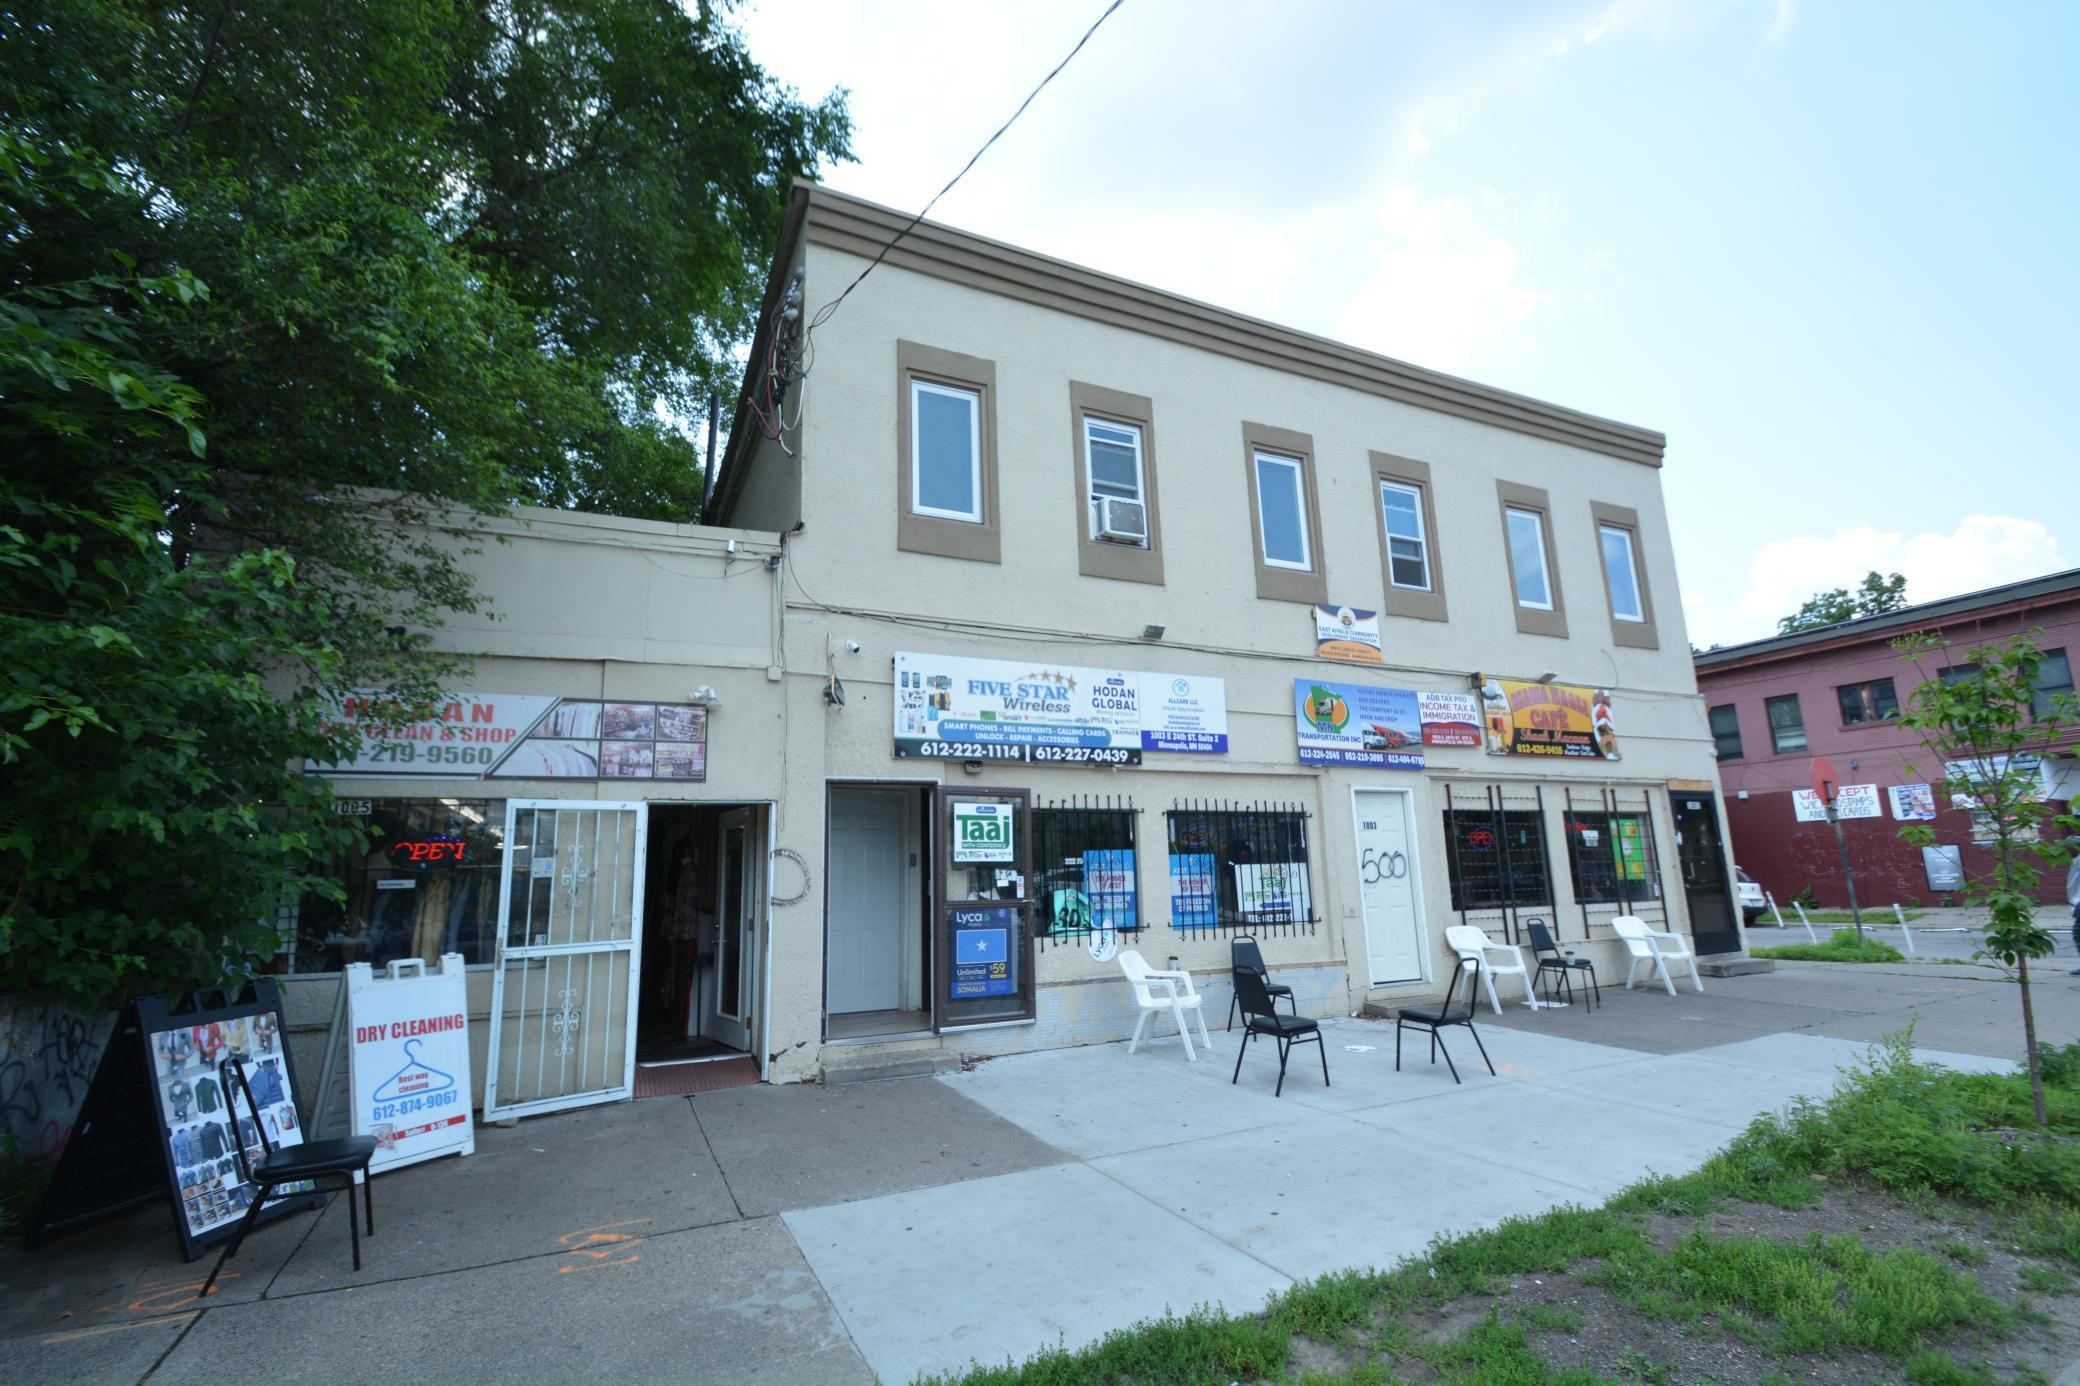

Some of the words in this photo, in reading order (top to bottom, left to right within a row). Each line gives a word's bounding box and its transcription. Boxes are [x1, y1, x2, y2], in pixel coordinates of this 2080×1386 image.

[968, 680, 1012, 696] FIVE
[1017, 683, 1069, 701] STAR
[1093, 686, 1135, 698] HODAN
[1003, 698, 1071, 713] Wireless
[1092, 698, 1137, 710] GLOBAL
[1420, 702, 1452, 711] INCOME
[1453, 704, 1468, 712] TAX
[1470, 704, 1476, 712] &
[1423, 712, 1476, 720] IMMIGRATION
[366, 724, 433, 740] CLEAN
[440, 730, 454, 741] &
[461, 728, 517, 744] SHOP
[944, 722, 968, 730] SMART
[969, 724, 998, 732] PHONES
[1018, 726, 1052, 734] PAYMENTS
[1057, 728, 1084, 736] CALLING
[975, 732, 1004, 740] UNLOCK
[1038, 736, 1080, 744] ACCESSORIES
[1298, 732, 1350, 742] TRANSPORTATION
[920, 742, 1020, 758] 612-222-1114
[1036, 746, 1129, 762] 612-227-0439
[1799, 791, 1818, 800] WE
[956, 814, 1010, 849] Taaj
[1362, 848, 1407, 884] 500
[956, 912, 983, 924] Lyca
[956, 968, 986, 976] Unlimited
[990, 963, 1006, 974] $59
[956, 986, 986, 994] SOMALIA
[356, 1024, 388, 1044] DRY
[391, 1014, 464, 1039] CLEANING
[398, 1074, 414, 1084] Best
[398, 1082, 429, 1094] cleaning
[373, 1090, 458, 1121] 612-874-9067
